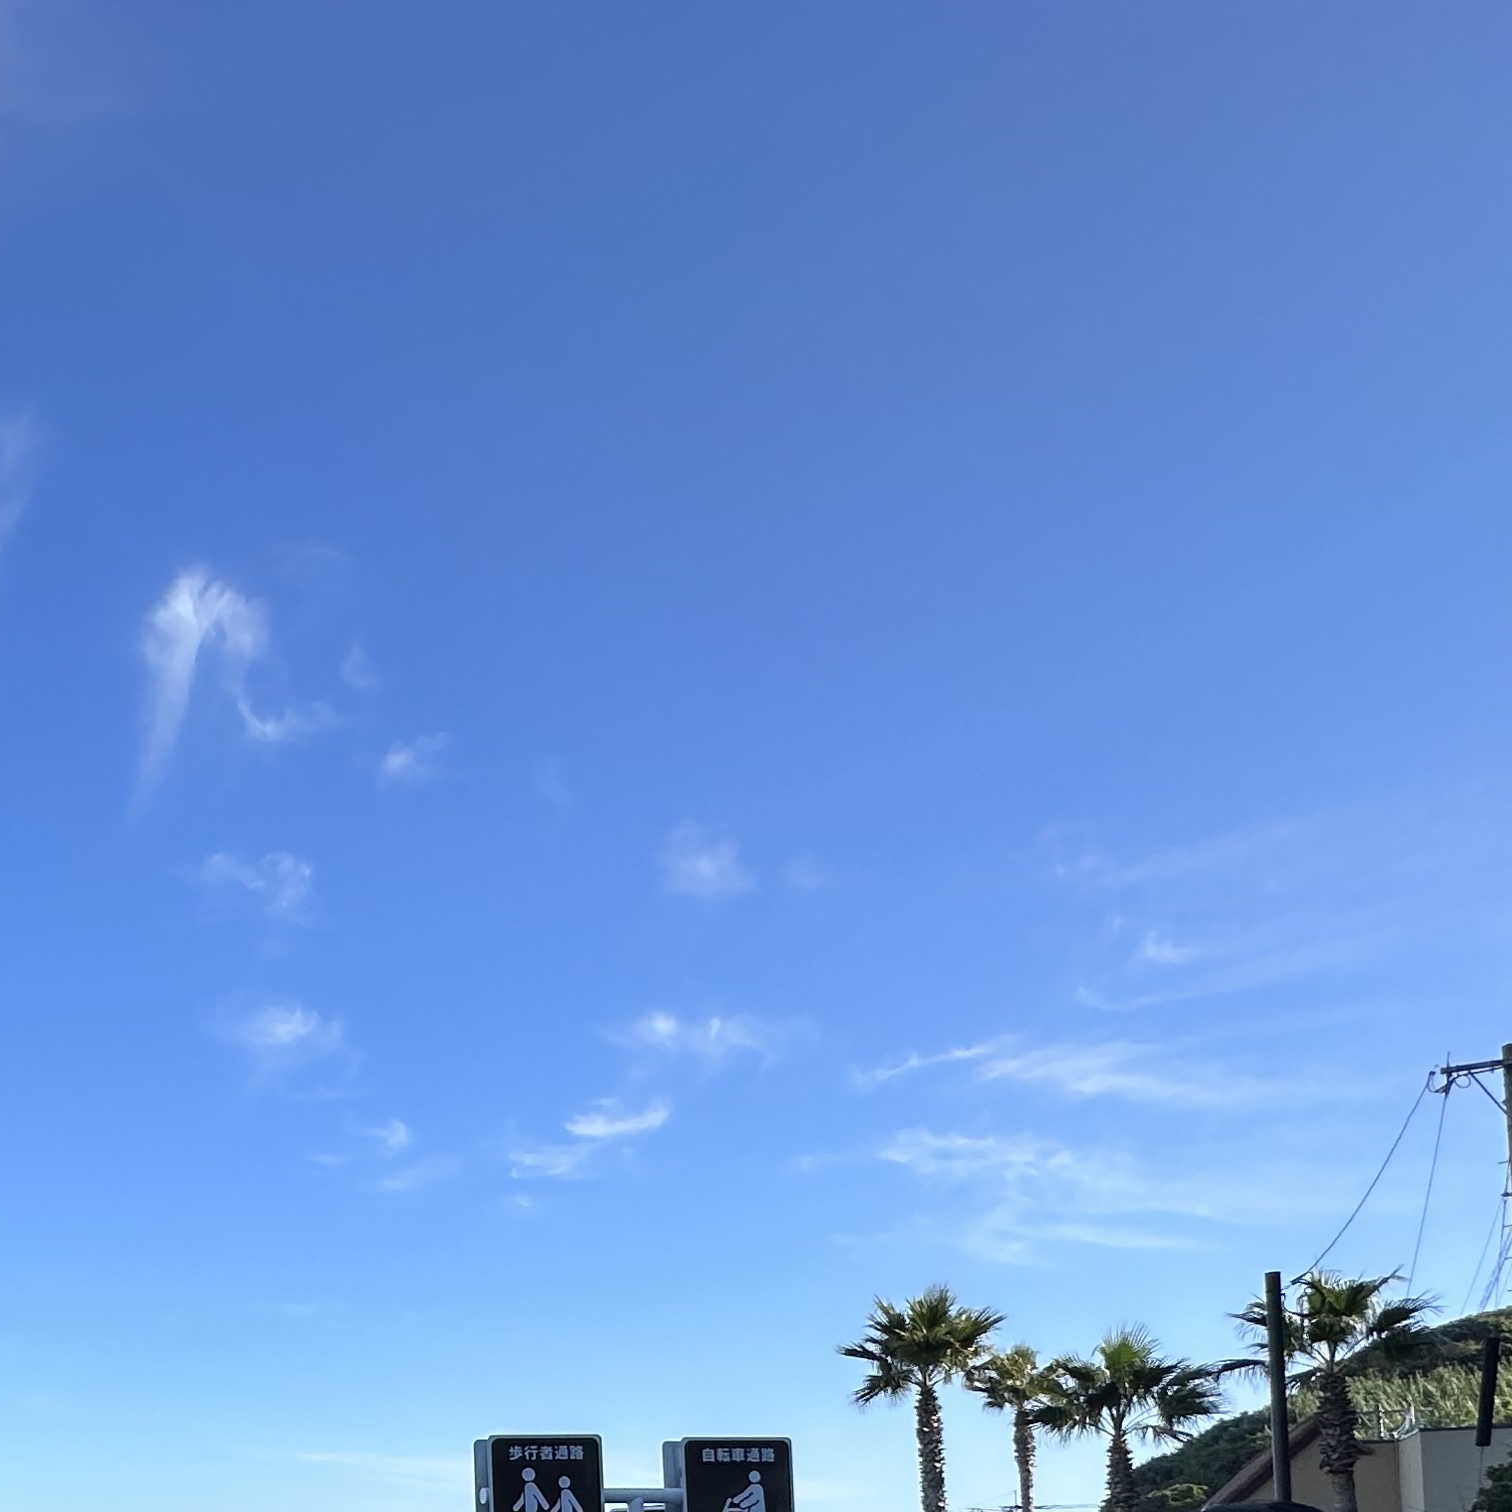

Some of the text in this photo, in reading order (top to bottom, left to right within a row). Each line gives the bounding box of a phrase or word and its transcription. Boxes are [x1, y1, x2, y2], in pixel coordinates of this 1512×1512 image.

[508, 1445, 584, 1461] 歩行者通路
[702, 1447, 775, 1462] 自転車通路
